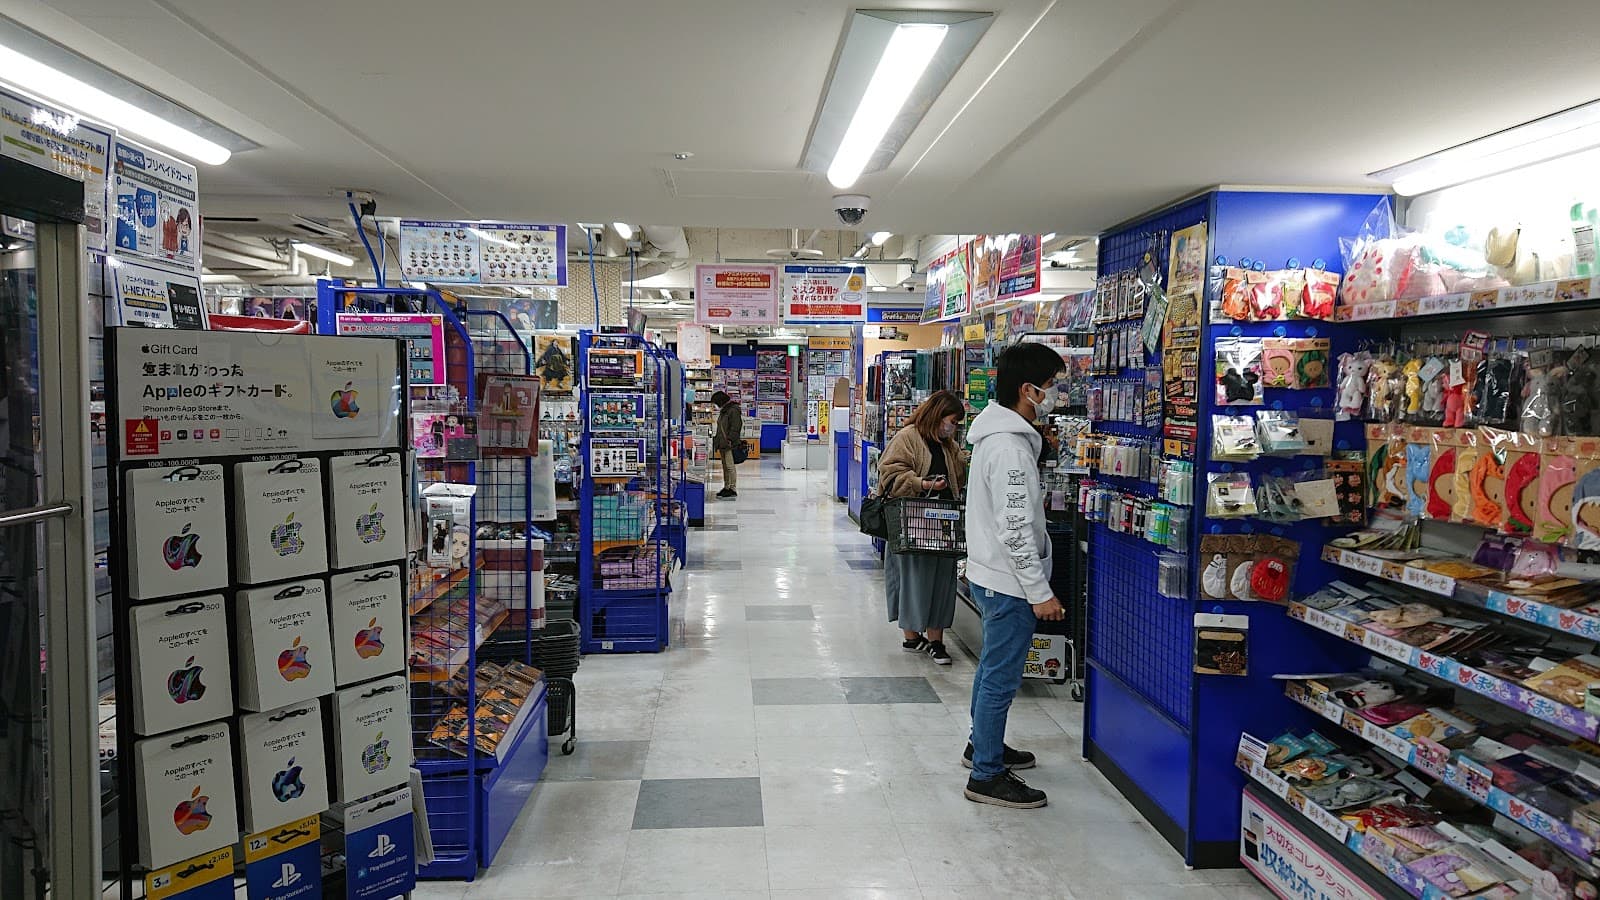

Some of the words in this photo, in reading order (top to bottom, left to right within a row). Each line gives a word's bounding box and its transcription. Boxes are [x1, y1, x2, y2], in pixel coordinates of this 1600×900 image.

[146, 157, 192, 184] プリペイドカード
[122, 284, 166, 300] U-NEXTカード
[791, 285, 840, 295] マスク着用が
[150, 344, 171, 354] Gift
[172, 344, 198, 355] Card
[142, 383, 293, 400] Appleのギフトカード。
[155, 497, 205, 507] Appleのすべてを
[269, 611, 312, 624] Appleのすべてを
[158, 628, 208, 643] Appleのすべてを
[164, 758, 213, 776] Appleのすべてを
